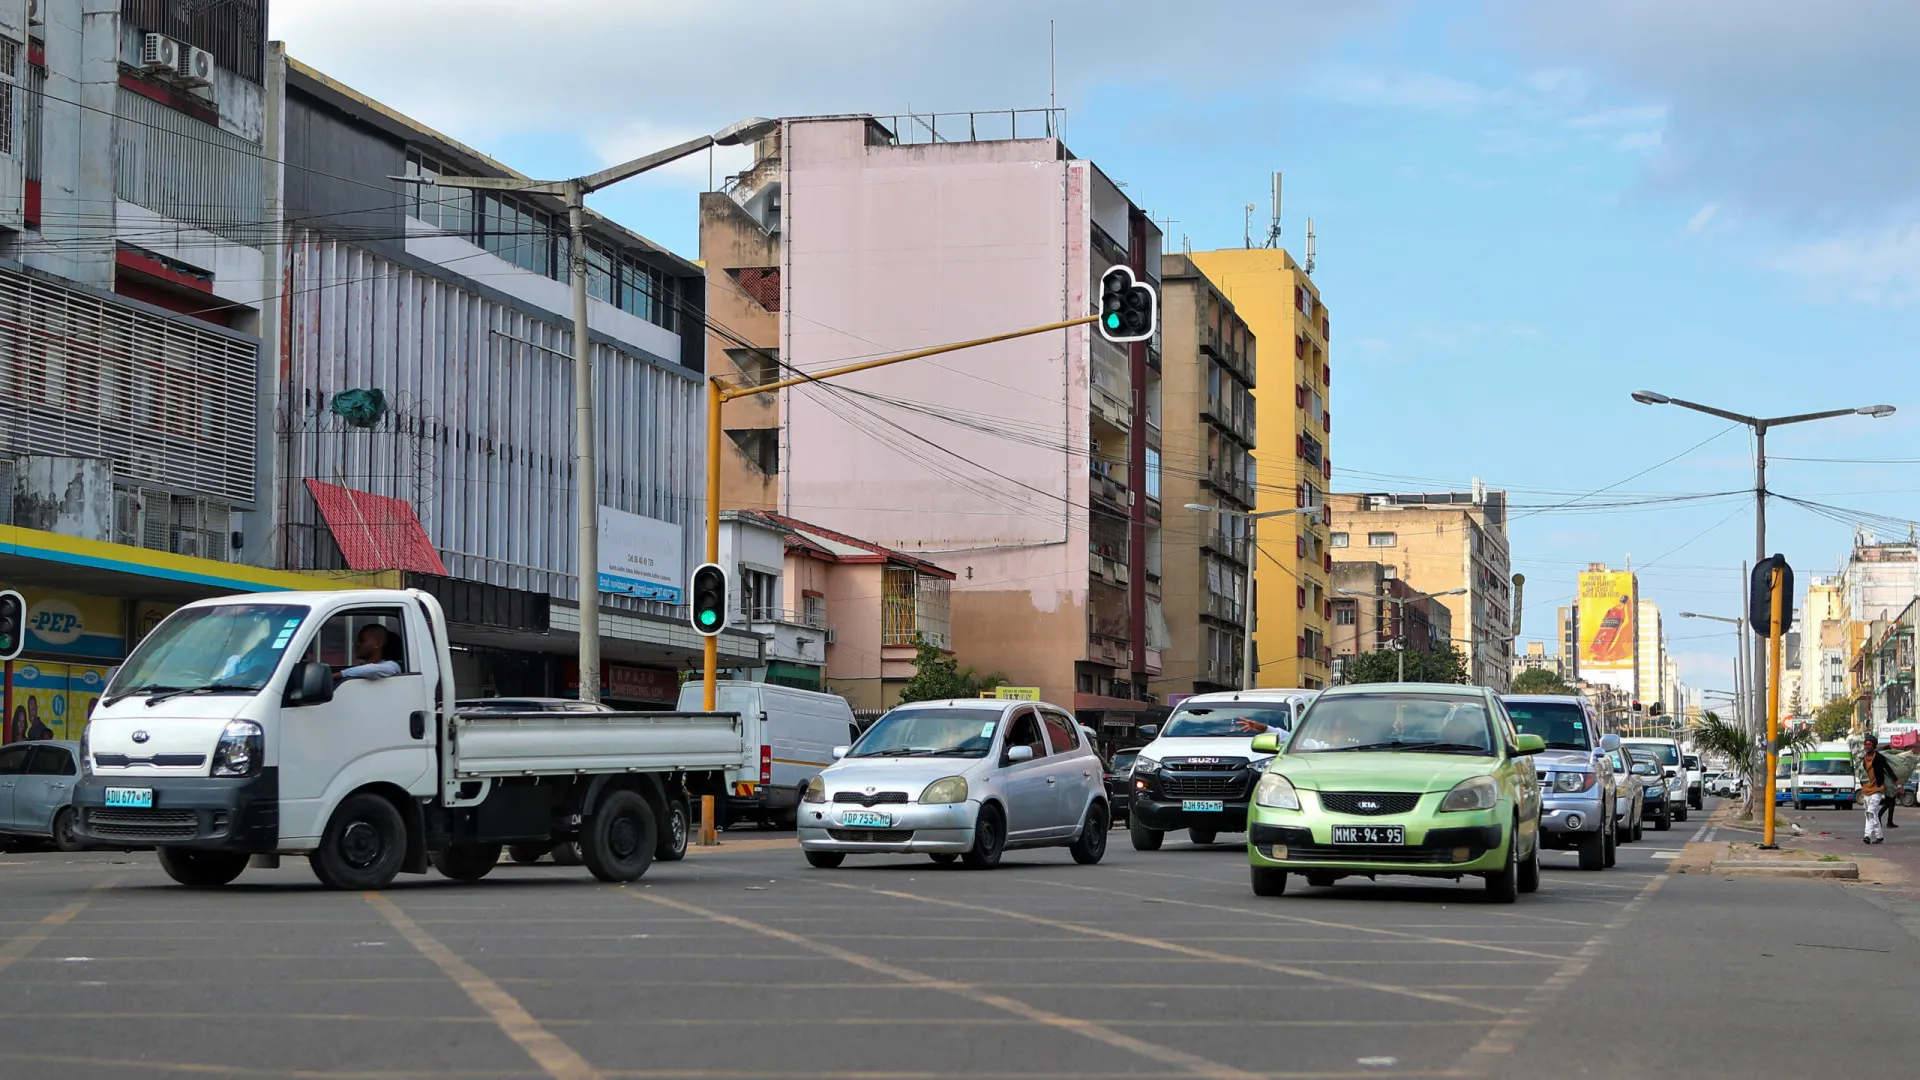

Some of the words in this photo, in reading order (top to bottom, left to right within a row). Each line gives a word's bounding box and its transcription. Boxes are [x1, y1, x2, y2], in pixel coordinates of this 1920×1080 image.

[36, 612, 77, 633] PEP
[106, 789, 121, 803] ADU
[122, 790, 136, 804] 677
[141, 791, 152, 805] MP
[1197, 801, 1209, 810] 951
[1213, 801, 1223, 810] MP
[859, 813, 874, 825] 753
